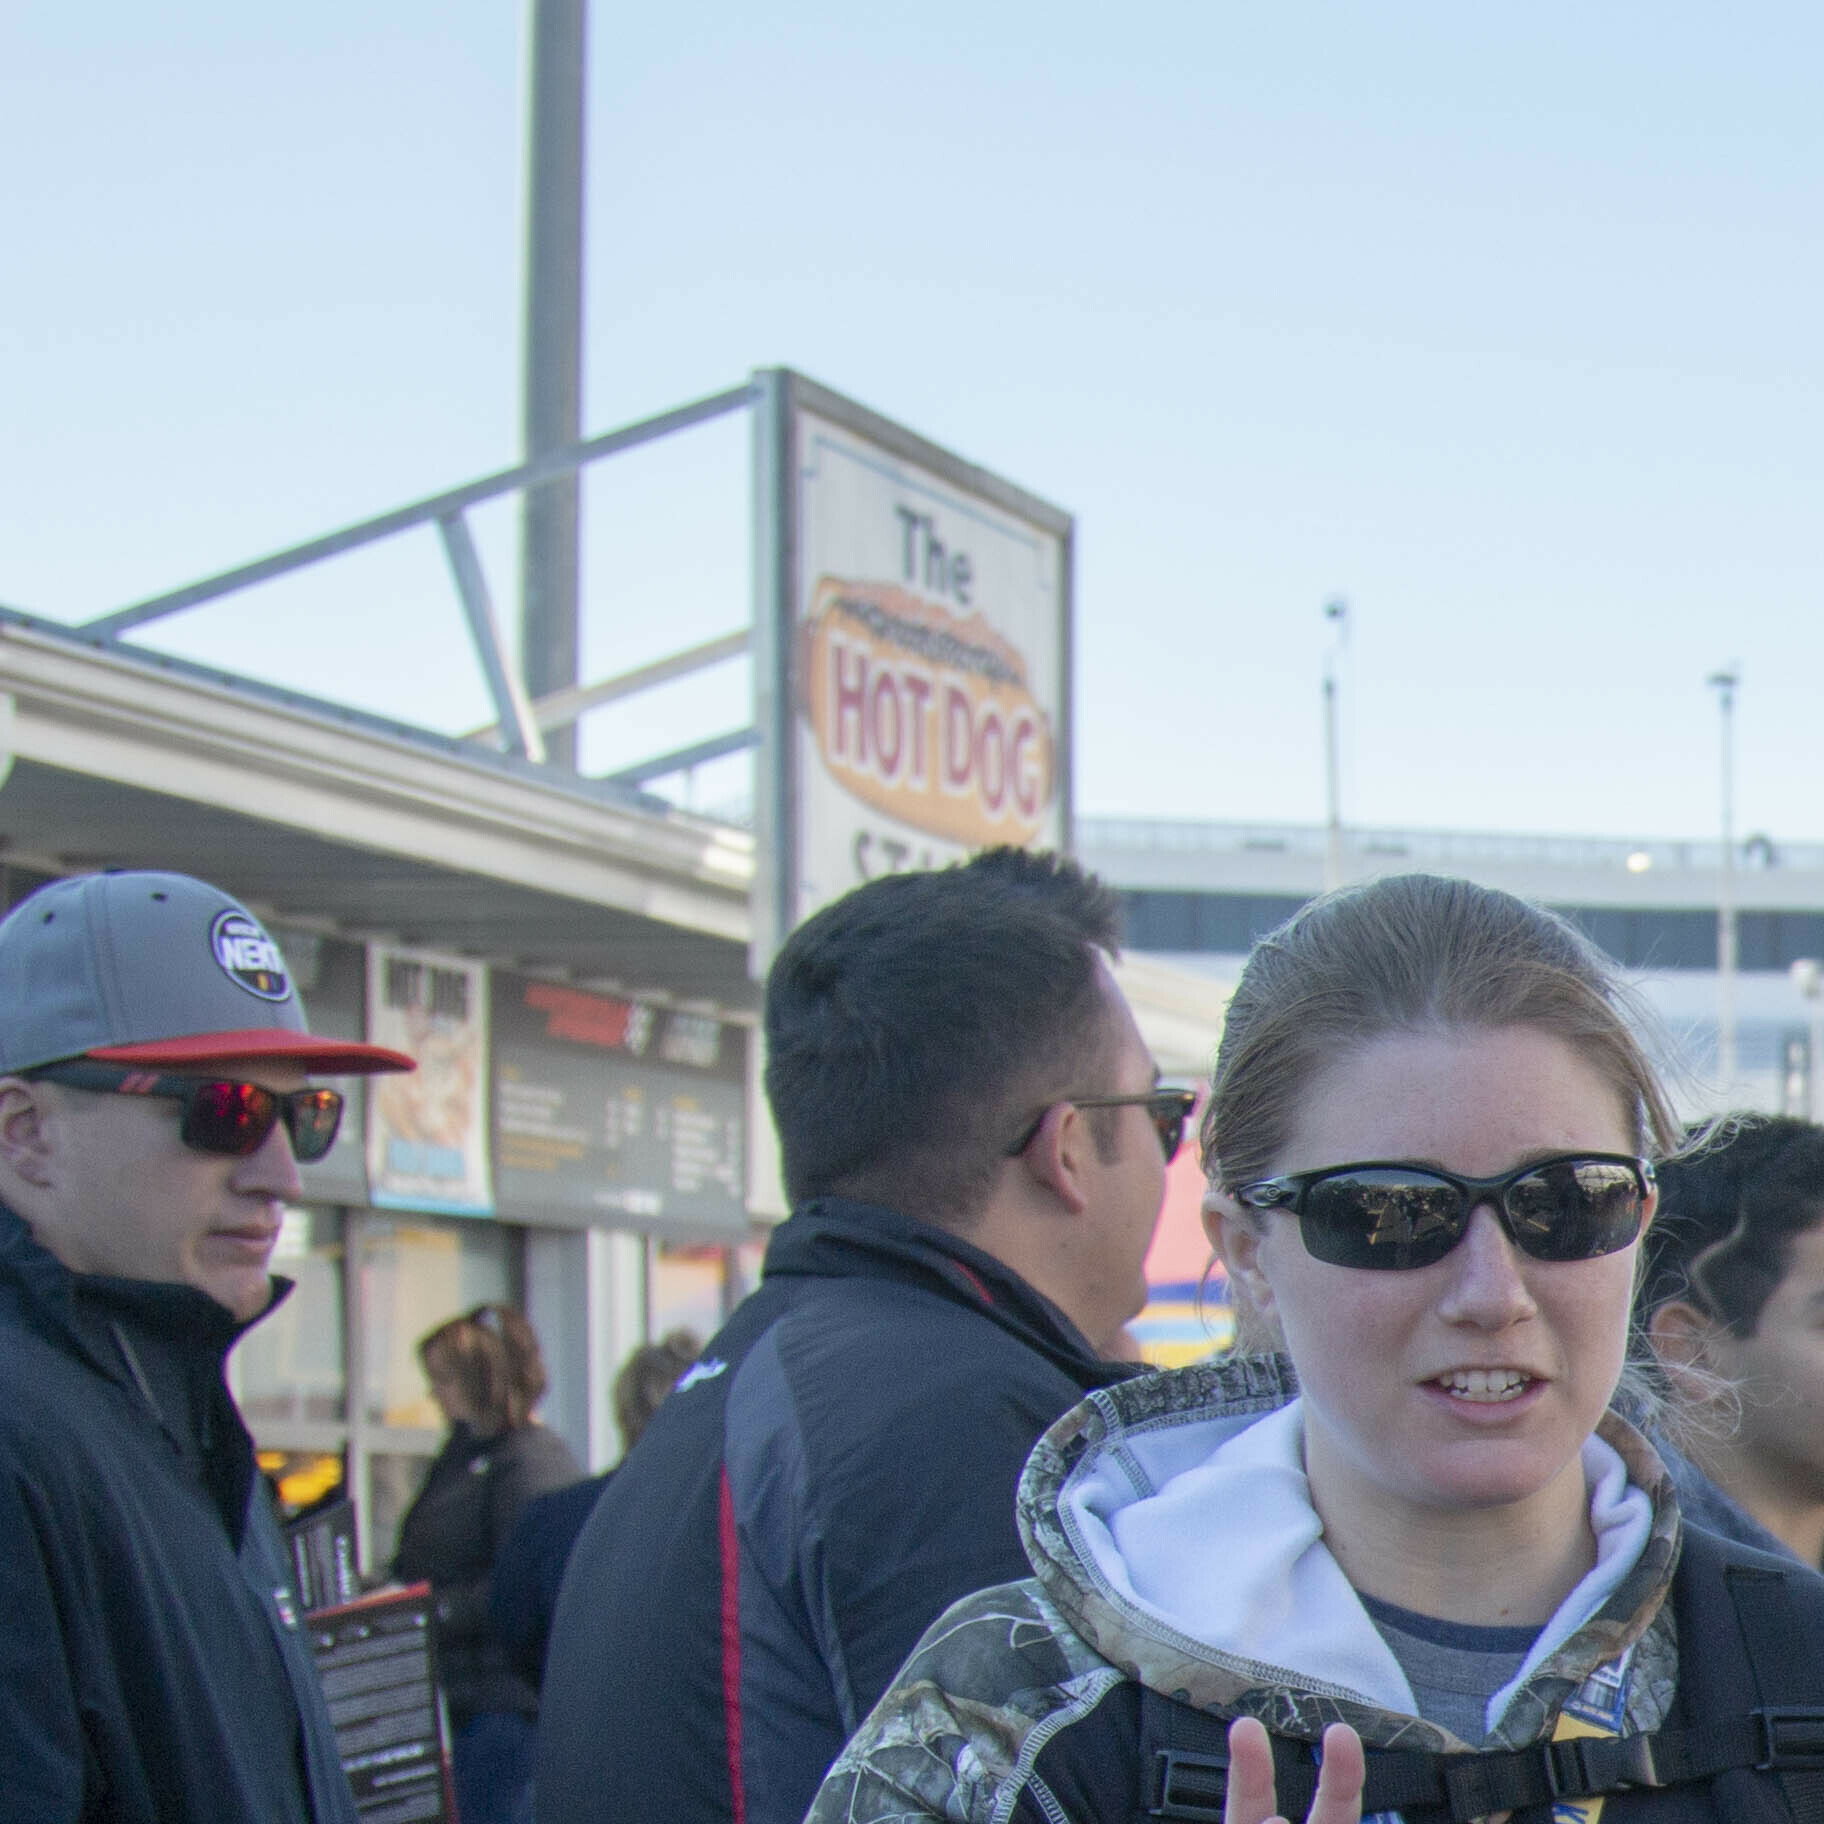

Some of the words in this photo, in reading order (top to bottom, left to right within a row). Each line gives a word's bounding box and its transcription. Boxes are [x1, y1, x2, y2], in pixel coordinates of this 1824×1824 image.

[895, 503, 973, 606] The
[834, 644, 932, 778] HOT
[946, 686, 1038, 818] DOG
